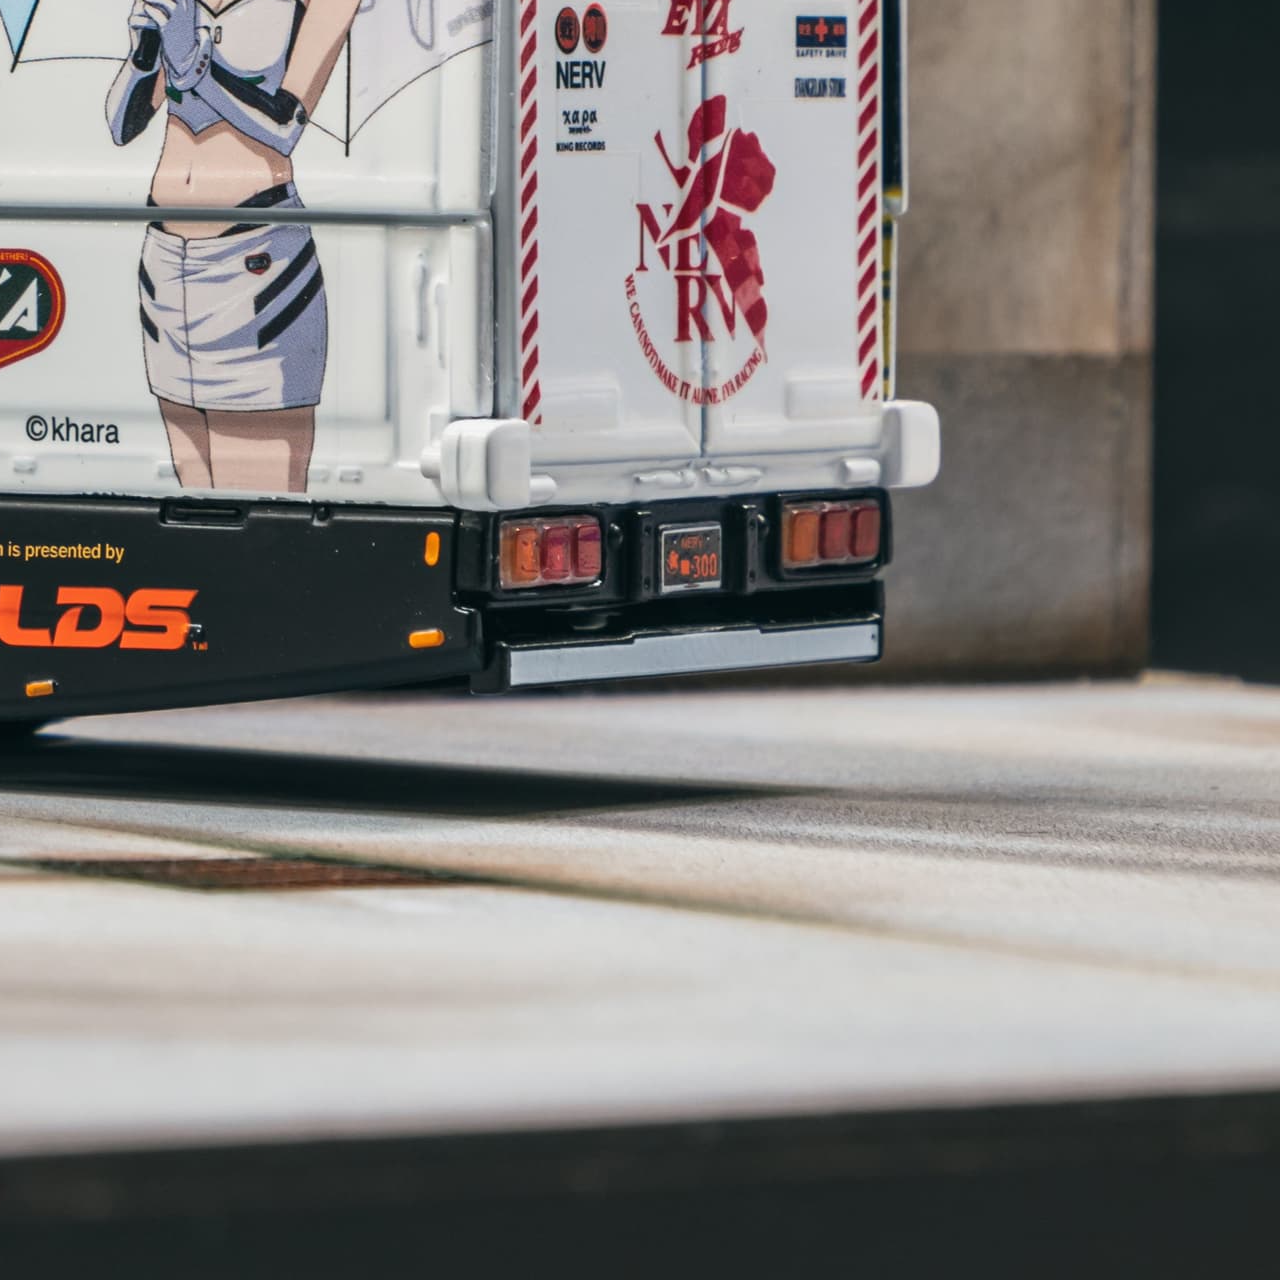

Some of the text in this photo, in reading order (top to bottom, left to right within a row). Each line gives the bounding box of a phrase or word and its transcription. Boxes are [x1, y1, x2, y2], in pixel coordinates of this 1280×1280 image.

[556, 60, 606, 89] NERV
[556, 140, 606, 152] KING RECORDS
[624, 273, 637, 300] WE
[679, 381, 691, 400] IT
[734, 348, 763, 389] RACING
[8, 541, 21, 558] is
[25, 542, 101, 561] presented
[106, 543, 125, 564] by
